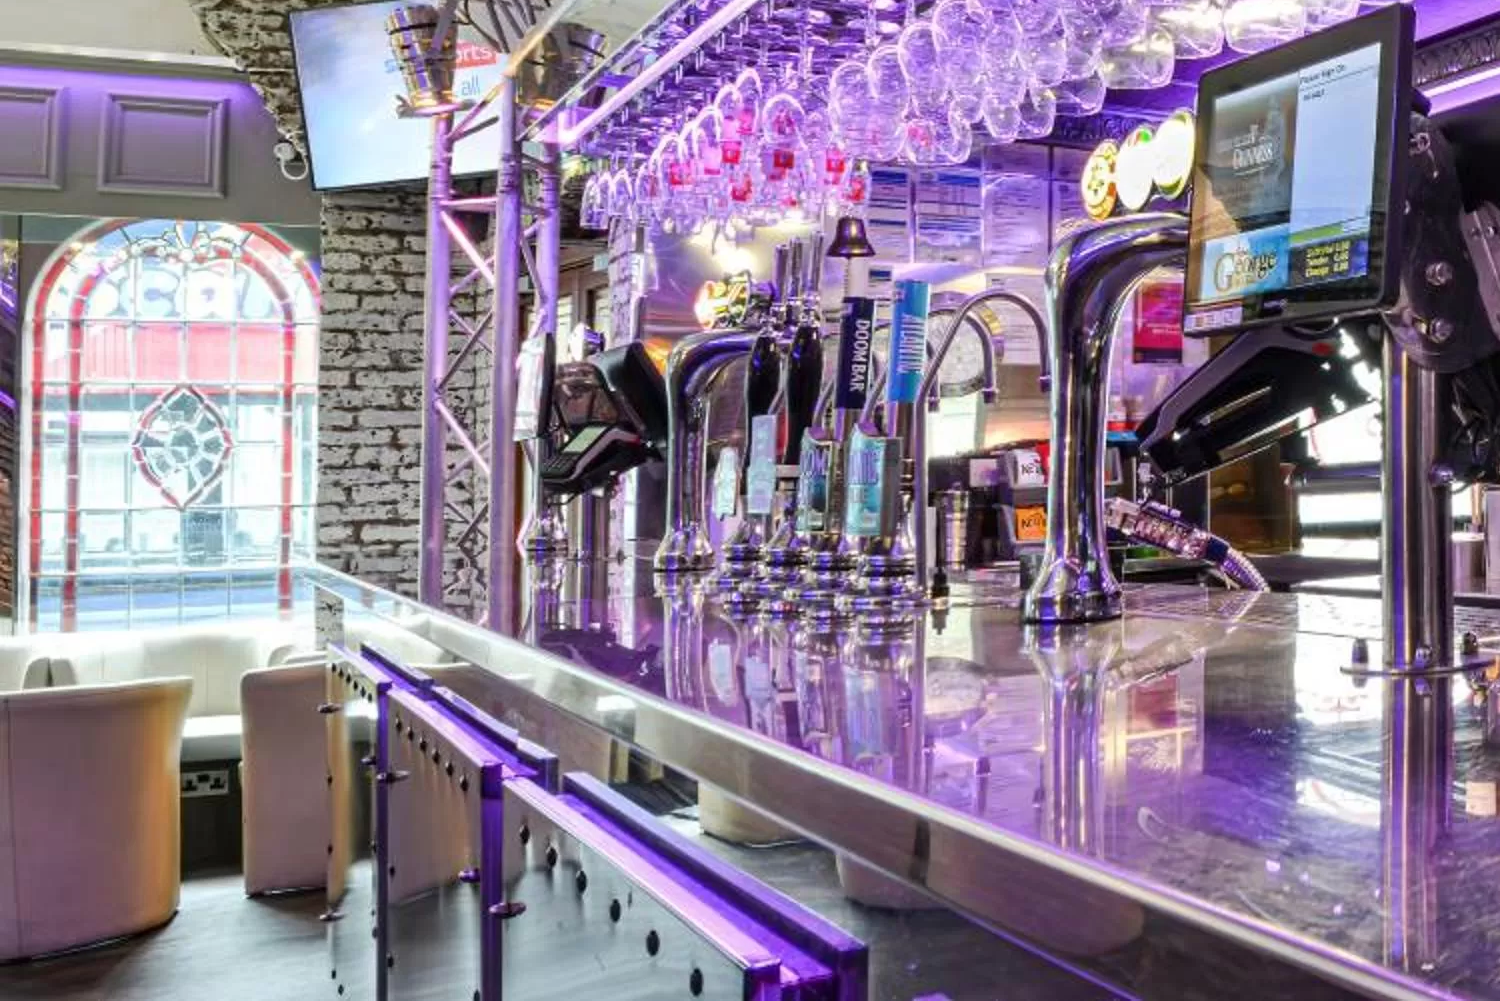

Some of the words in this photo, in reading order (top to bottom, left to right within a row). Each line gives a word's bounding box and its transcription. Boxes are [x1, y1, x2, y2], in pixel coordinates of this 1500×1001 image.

[461, 74, 480, 97] all
[852, 319, 871, 363] DOOM
[850, 364, 867, 392] BAR
